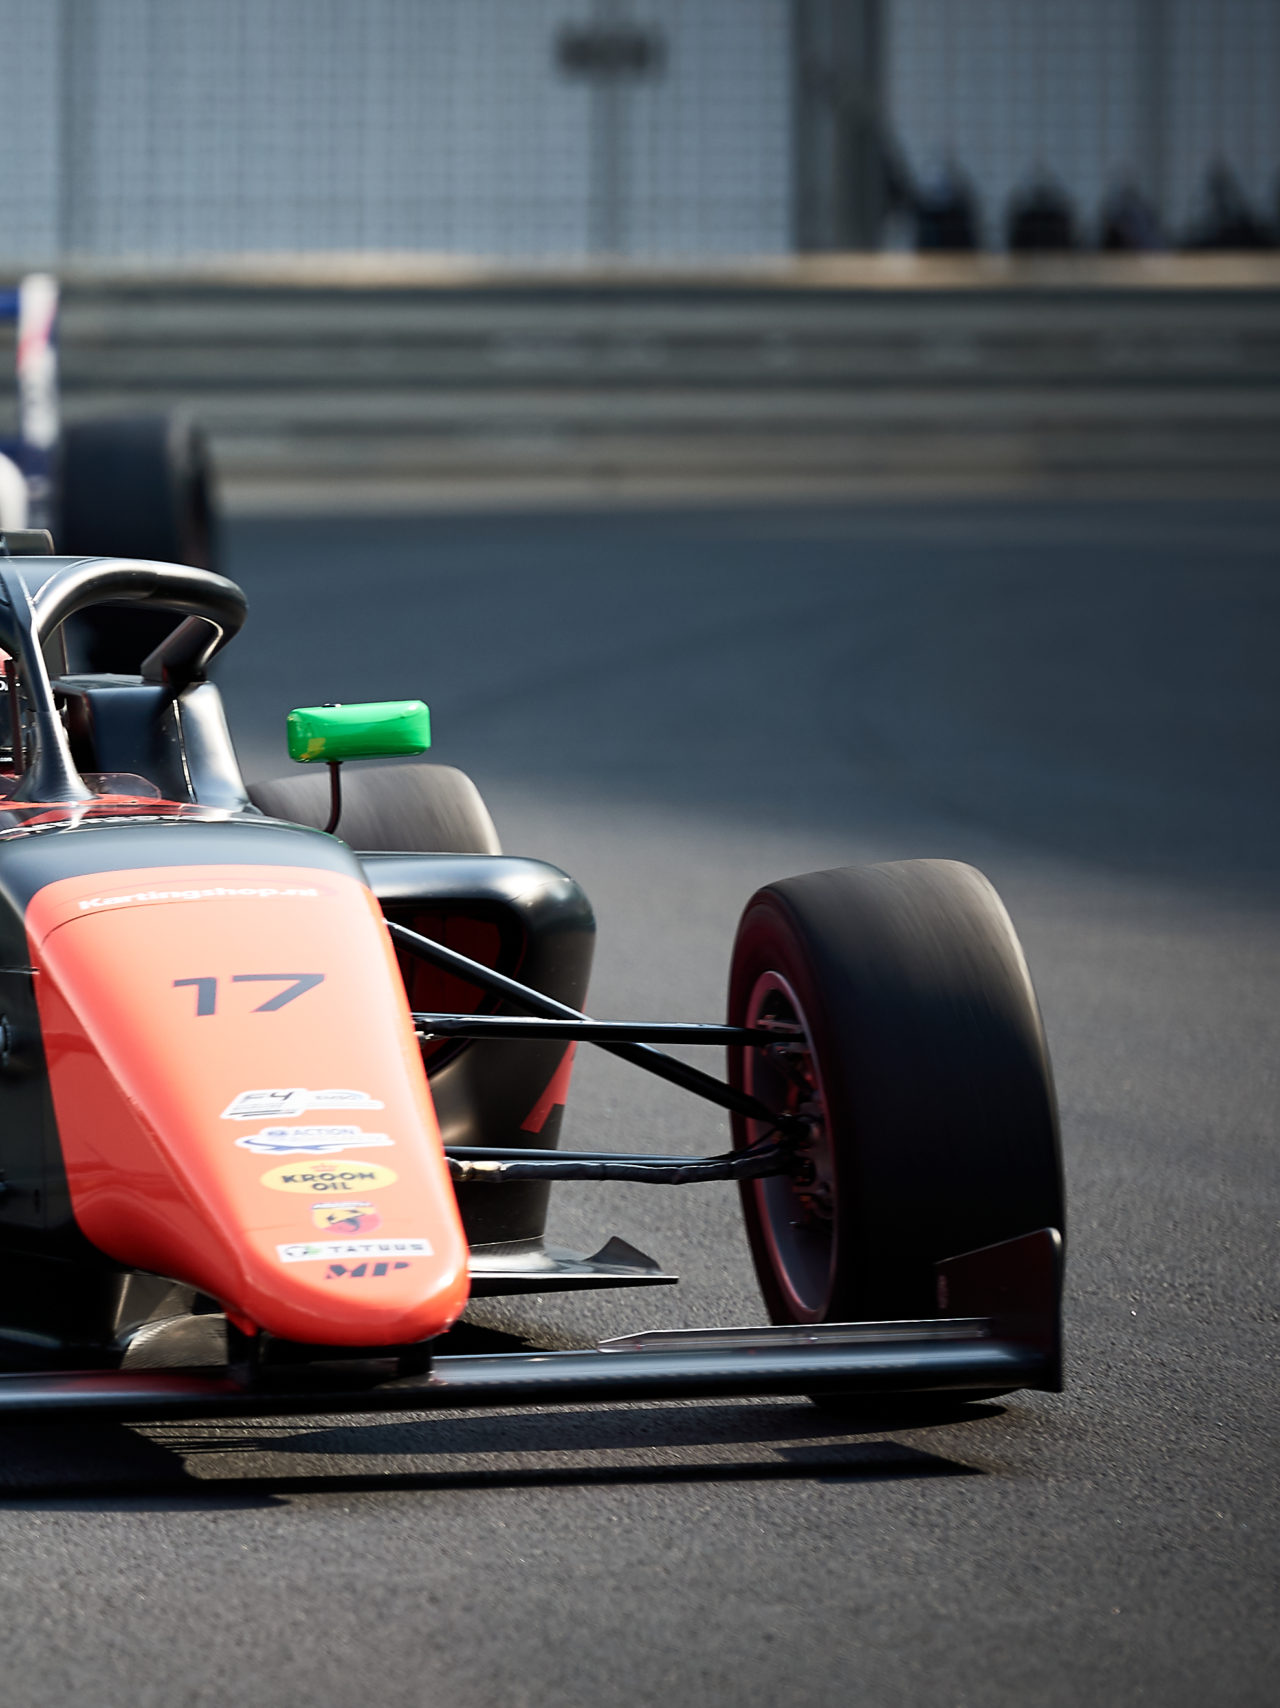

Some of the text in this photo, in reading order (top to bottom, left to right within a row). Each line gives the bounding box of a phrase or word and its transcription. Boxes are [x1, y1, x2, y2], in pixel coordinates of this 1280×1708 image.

[172, 972, 326, 1018] 17
[312, 1183, 352, 1191] OIL
[328, 1243, 424, 1254] TATUUS
[325, 1262, 410, 1280] MP
